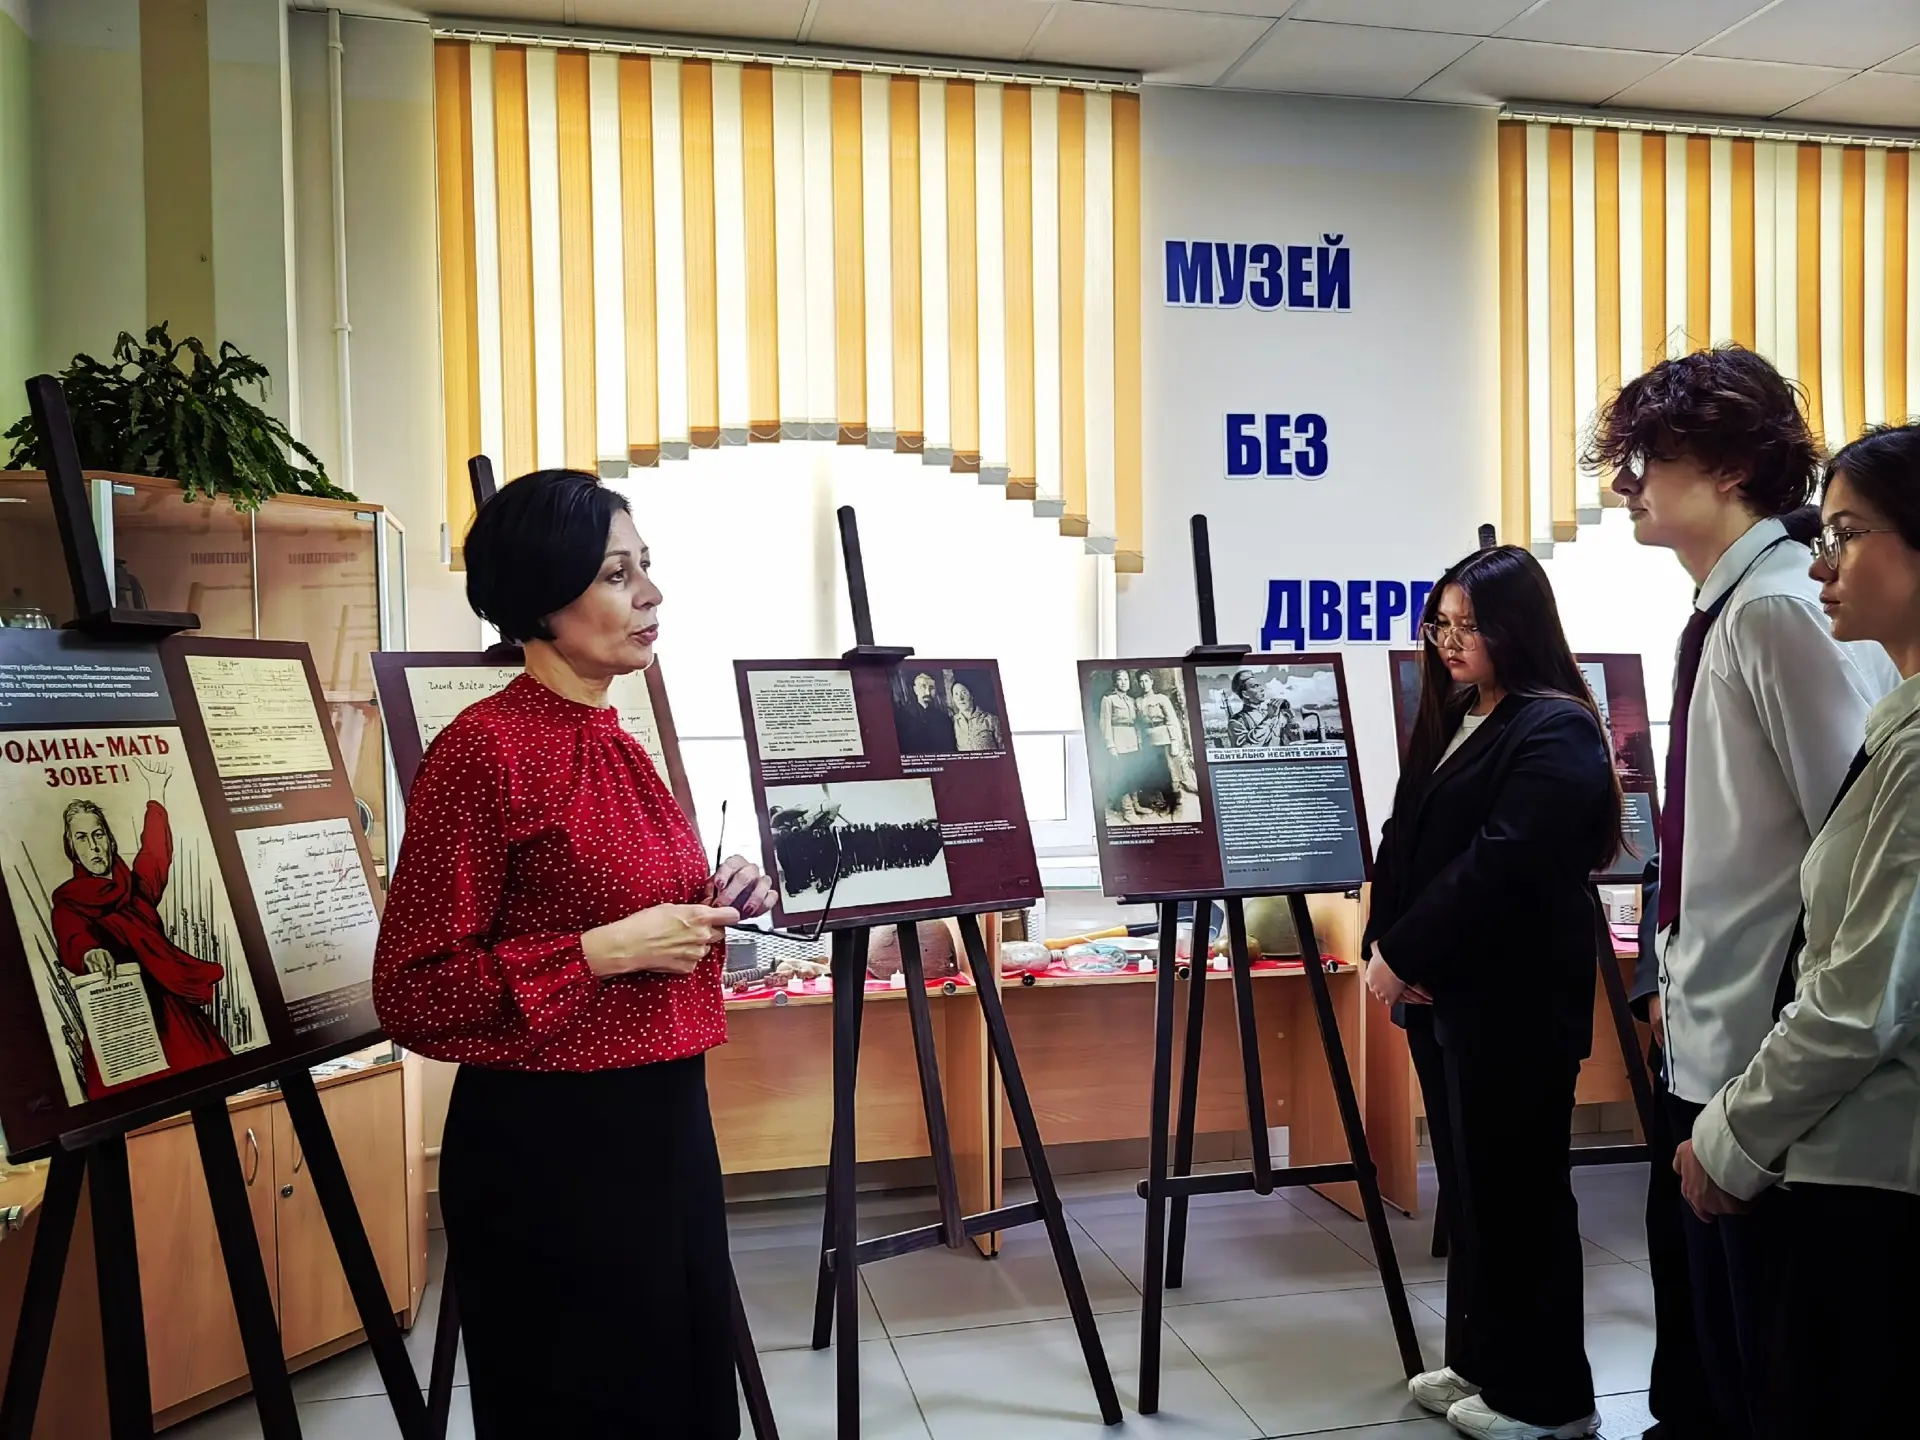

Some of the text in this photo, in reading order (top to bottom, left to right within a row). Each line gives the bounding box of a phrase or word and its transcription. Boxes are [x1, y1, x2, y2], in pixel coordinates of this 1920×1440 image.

[1164, 233, 1351, 310] МУЗЕЙ
[1225, 413, 1329, 477] БЕЗ
[0, 734, 170, 764] ОДИНА-МАТЬ
[1213, 749, 1340, 760] БДИТЕЛЬНО НЕСИТЕ СЛУЖБУ!
[44, 764, 130, 788] ЗОВЕТ!
